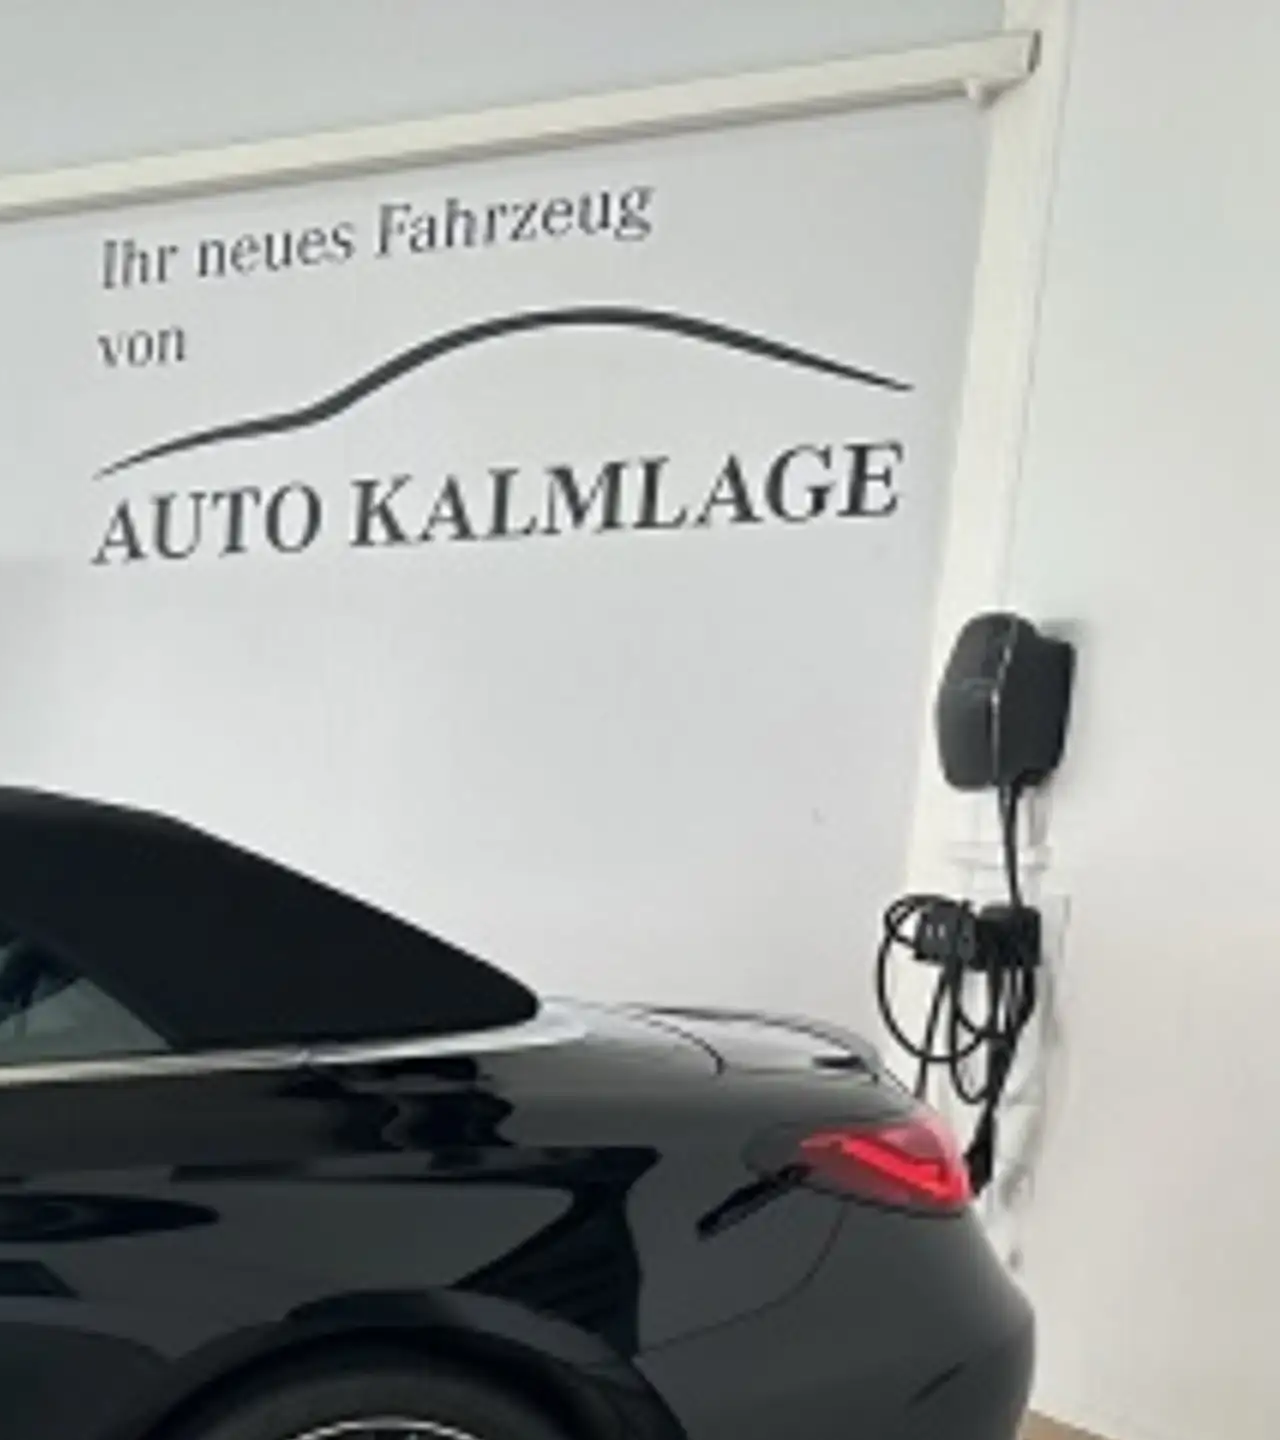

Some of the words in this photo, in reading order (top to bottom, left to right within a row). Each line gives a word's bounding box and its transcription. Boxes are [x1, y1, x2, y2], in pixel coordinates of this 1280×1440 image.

[103, 241, 179, 290] Ihr
[198, 226, 355, 278] neues
[377, 186, 653, 258] Fahrzeug
[97, 328, 186, 367] von
[91, 481, 322, 566] AUTO
[349, 440, 904, 548] KALMLAGE
